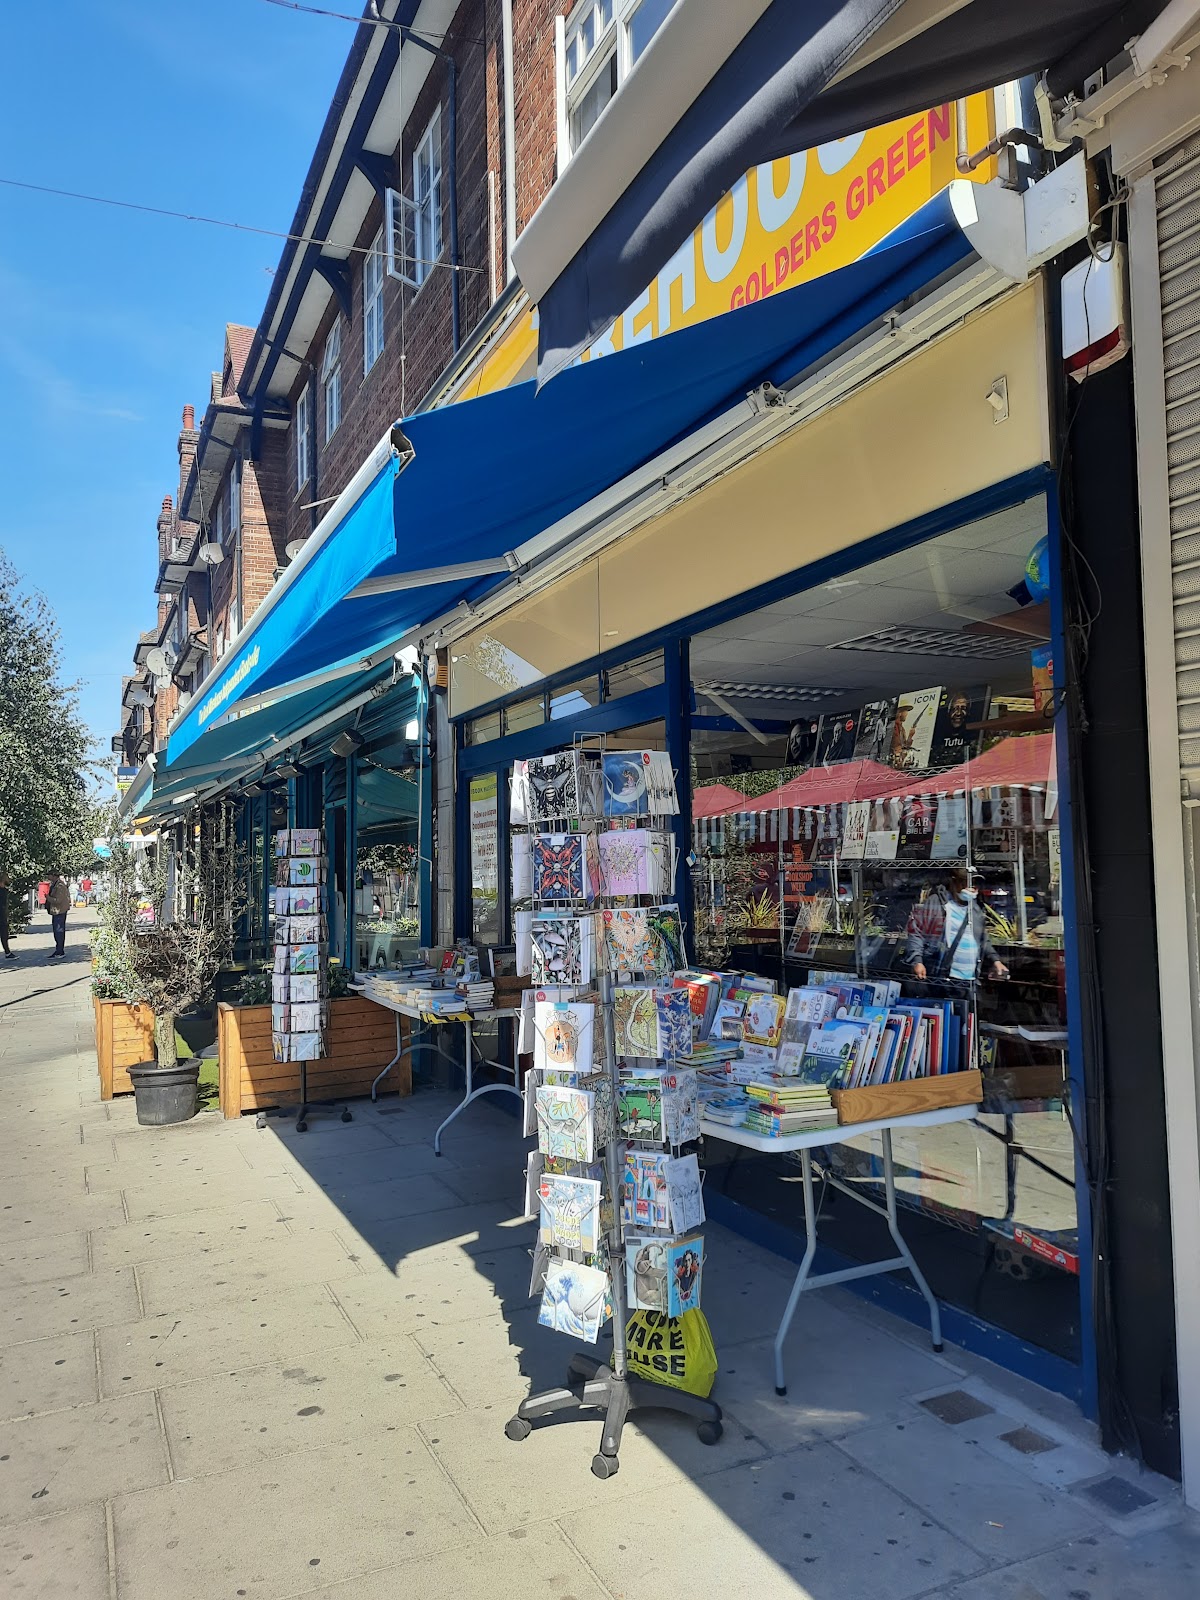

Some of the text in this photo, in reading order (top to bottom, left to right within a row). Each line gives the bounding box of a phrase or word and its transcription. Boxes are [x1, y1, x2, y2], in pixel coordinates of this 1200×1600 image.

[729, 102, 950, 311] GOLDERS GREEN
[913, 693, 936, 704] ICON
[944, 737, 963, 747] Tutu
[908, 817, 929, 827] CAR
[906, 827, 927, 835] BIBLE
[816, 1046, 836, 1055] HULK
